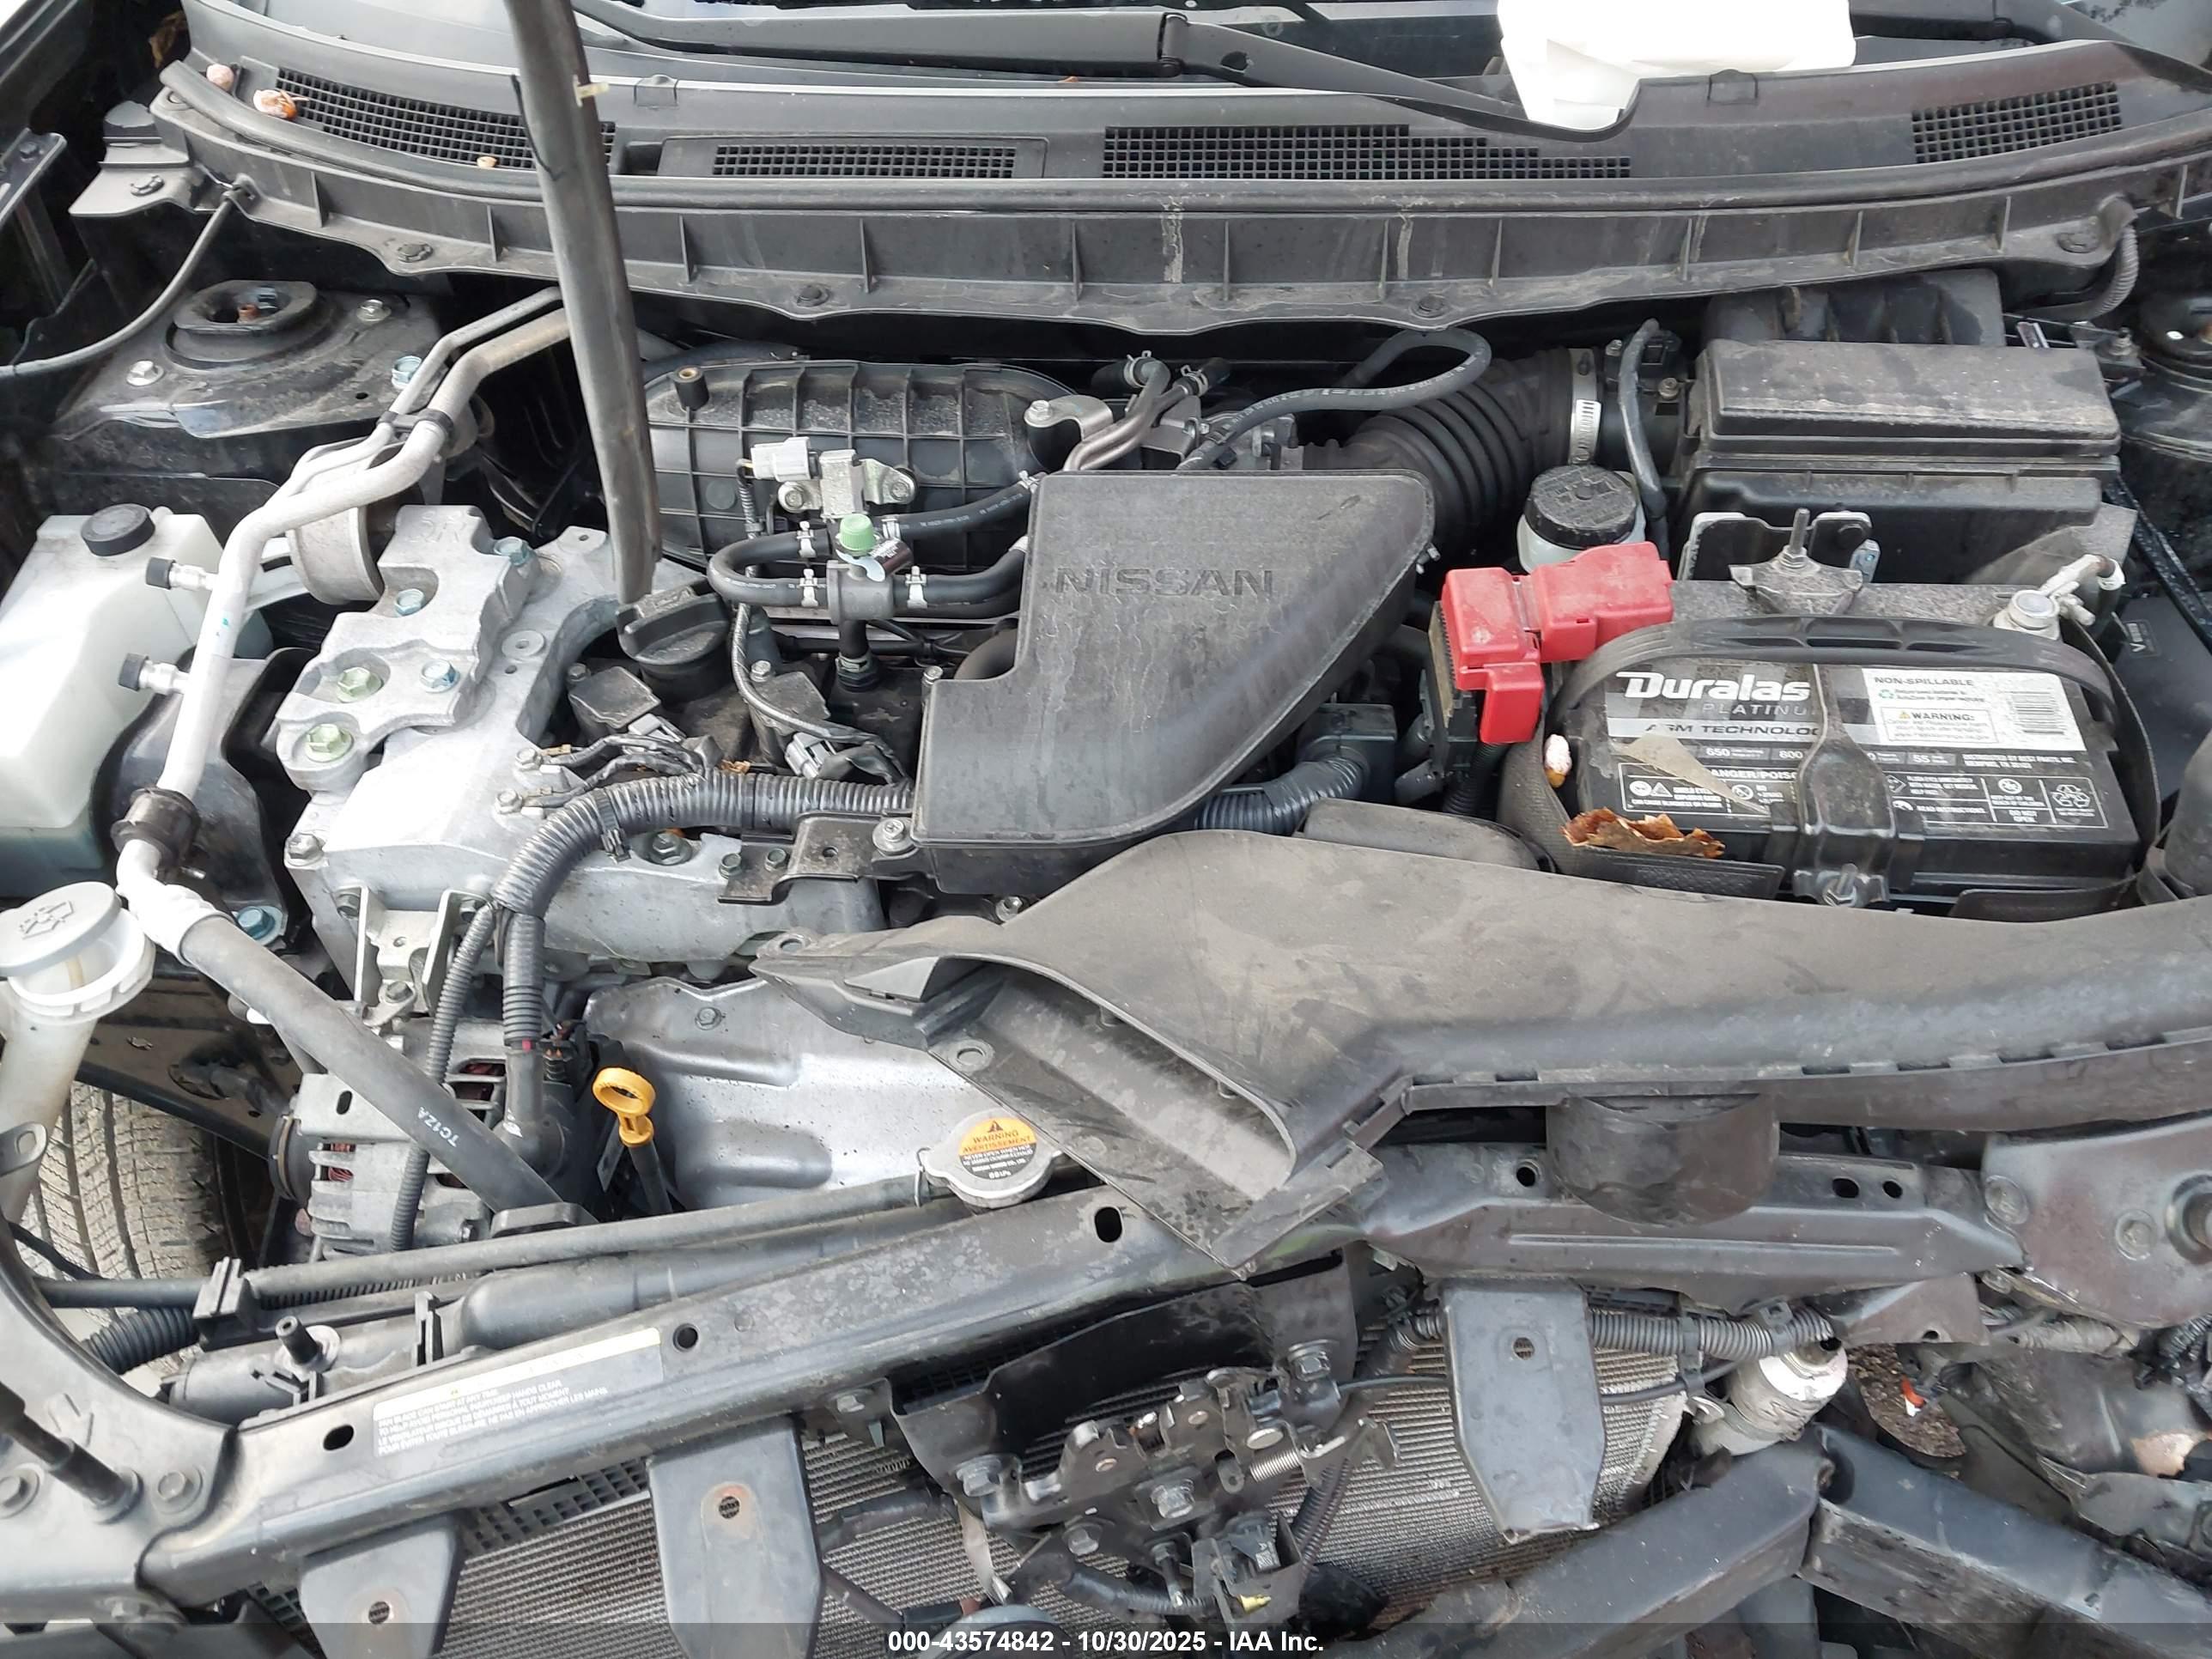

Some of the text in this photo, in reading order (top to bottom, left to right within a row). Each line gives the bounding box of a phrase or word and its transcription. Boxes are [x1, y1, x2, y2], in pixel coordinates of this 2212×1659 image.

[1055, 568, 1273, 596] NISSAN
[1616, 672, 1811, 702] Duralas
[1874, 676, 1974, 686] NON-SPILLABLE
[1703, 703, 1814, 716] PLATINU
[1911, 712, 1975, 721] WARNING:
[972, 1130, 1019, 1144] WARNING
